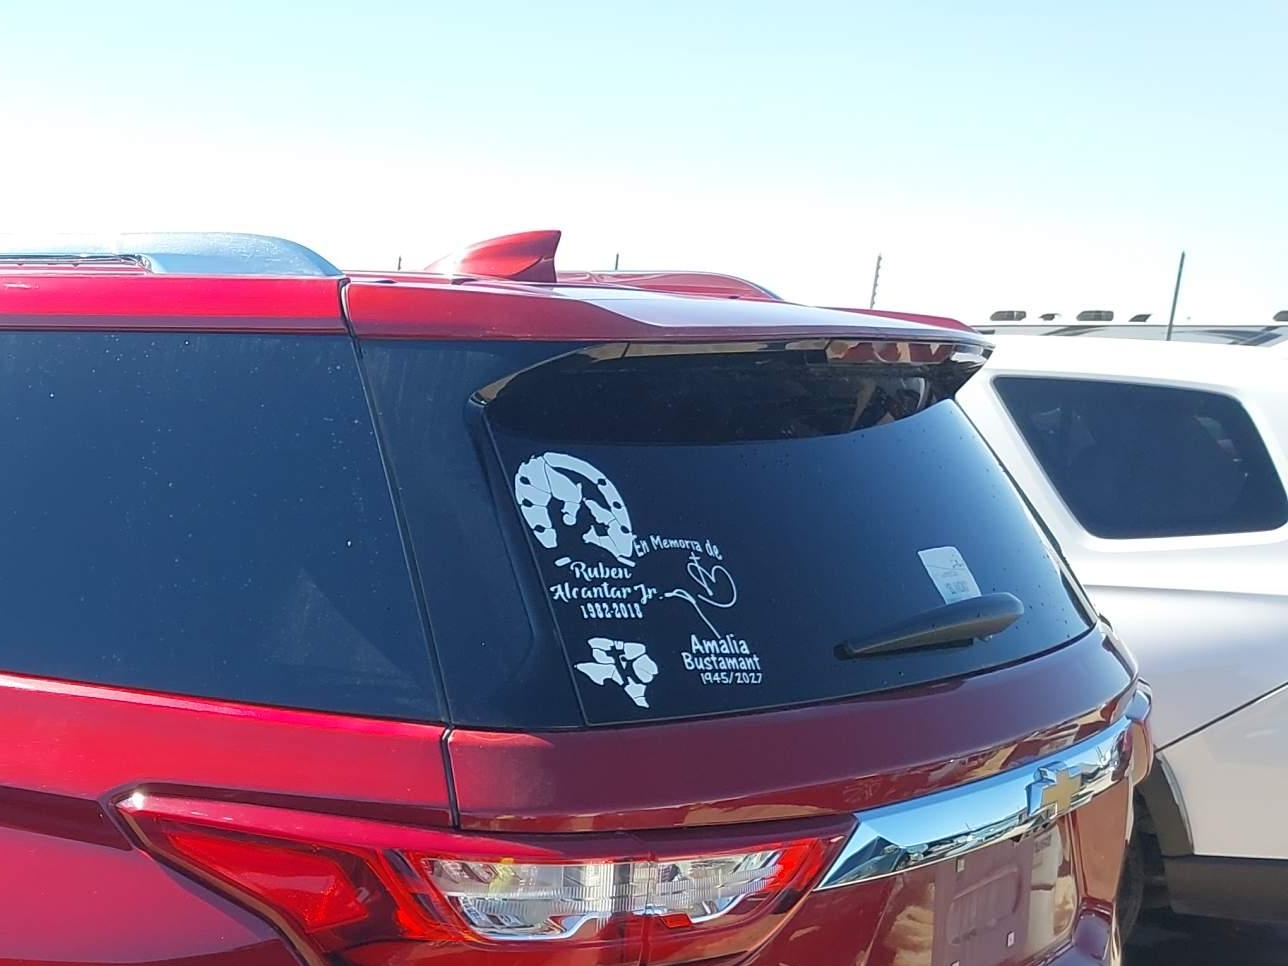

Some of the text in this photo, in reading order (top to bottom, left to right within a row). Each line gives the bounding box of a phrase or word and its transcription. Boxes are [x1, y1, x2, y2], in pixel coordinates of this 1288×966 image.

[650, 535, 702, 553] Memoria
[705, 539, 723, 561] de
[570, 561, 632, 581] Ruben
[549, 582, 665, 605] Alcantar Jr.
[690, 634, 750, 655] Amalia
[681, 652, 761, 671] Bustamant
